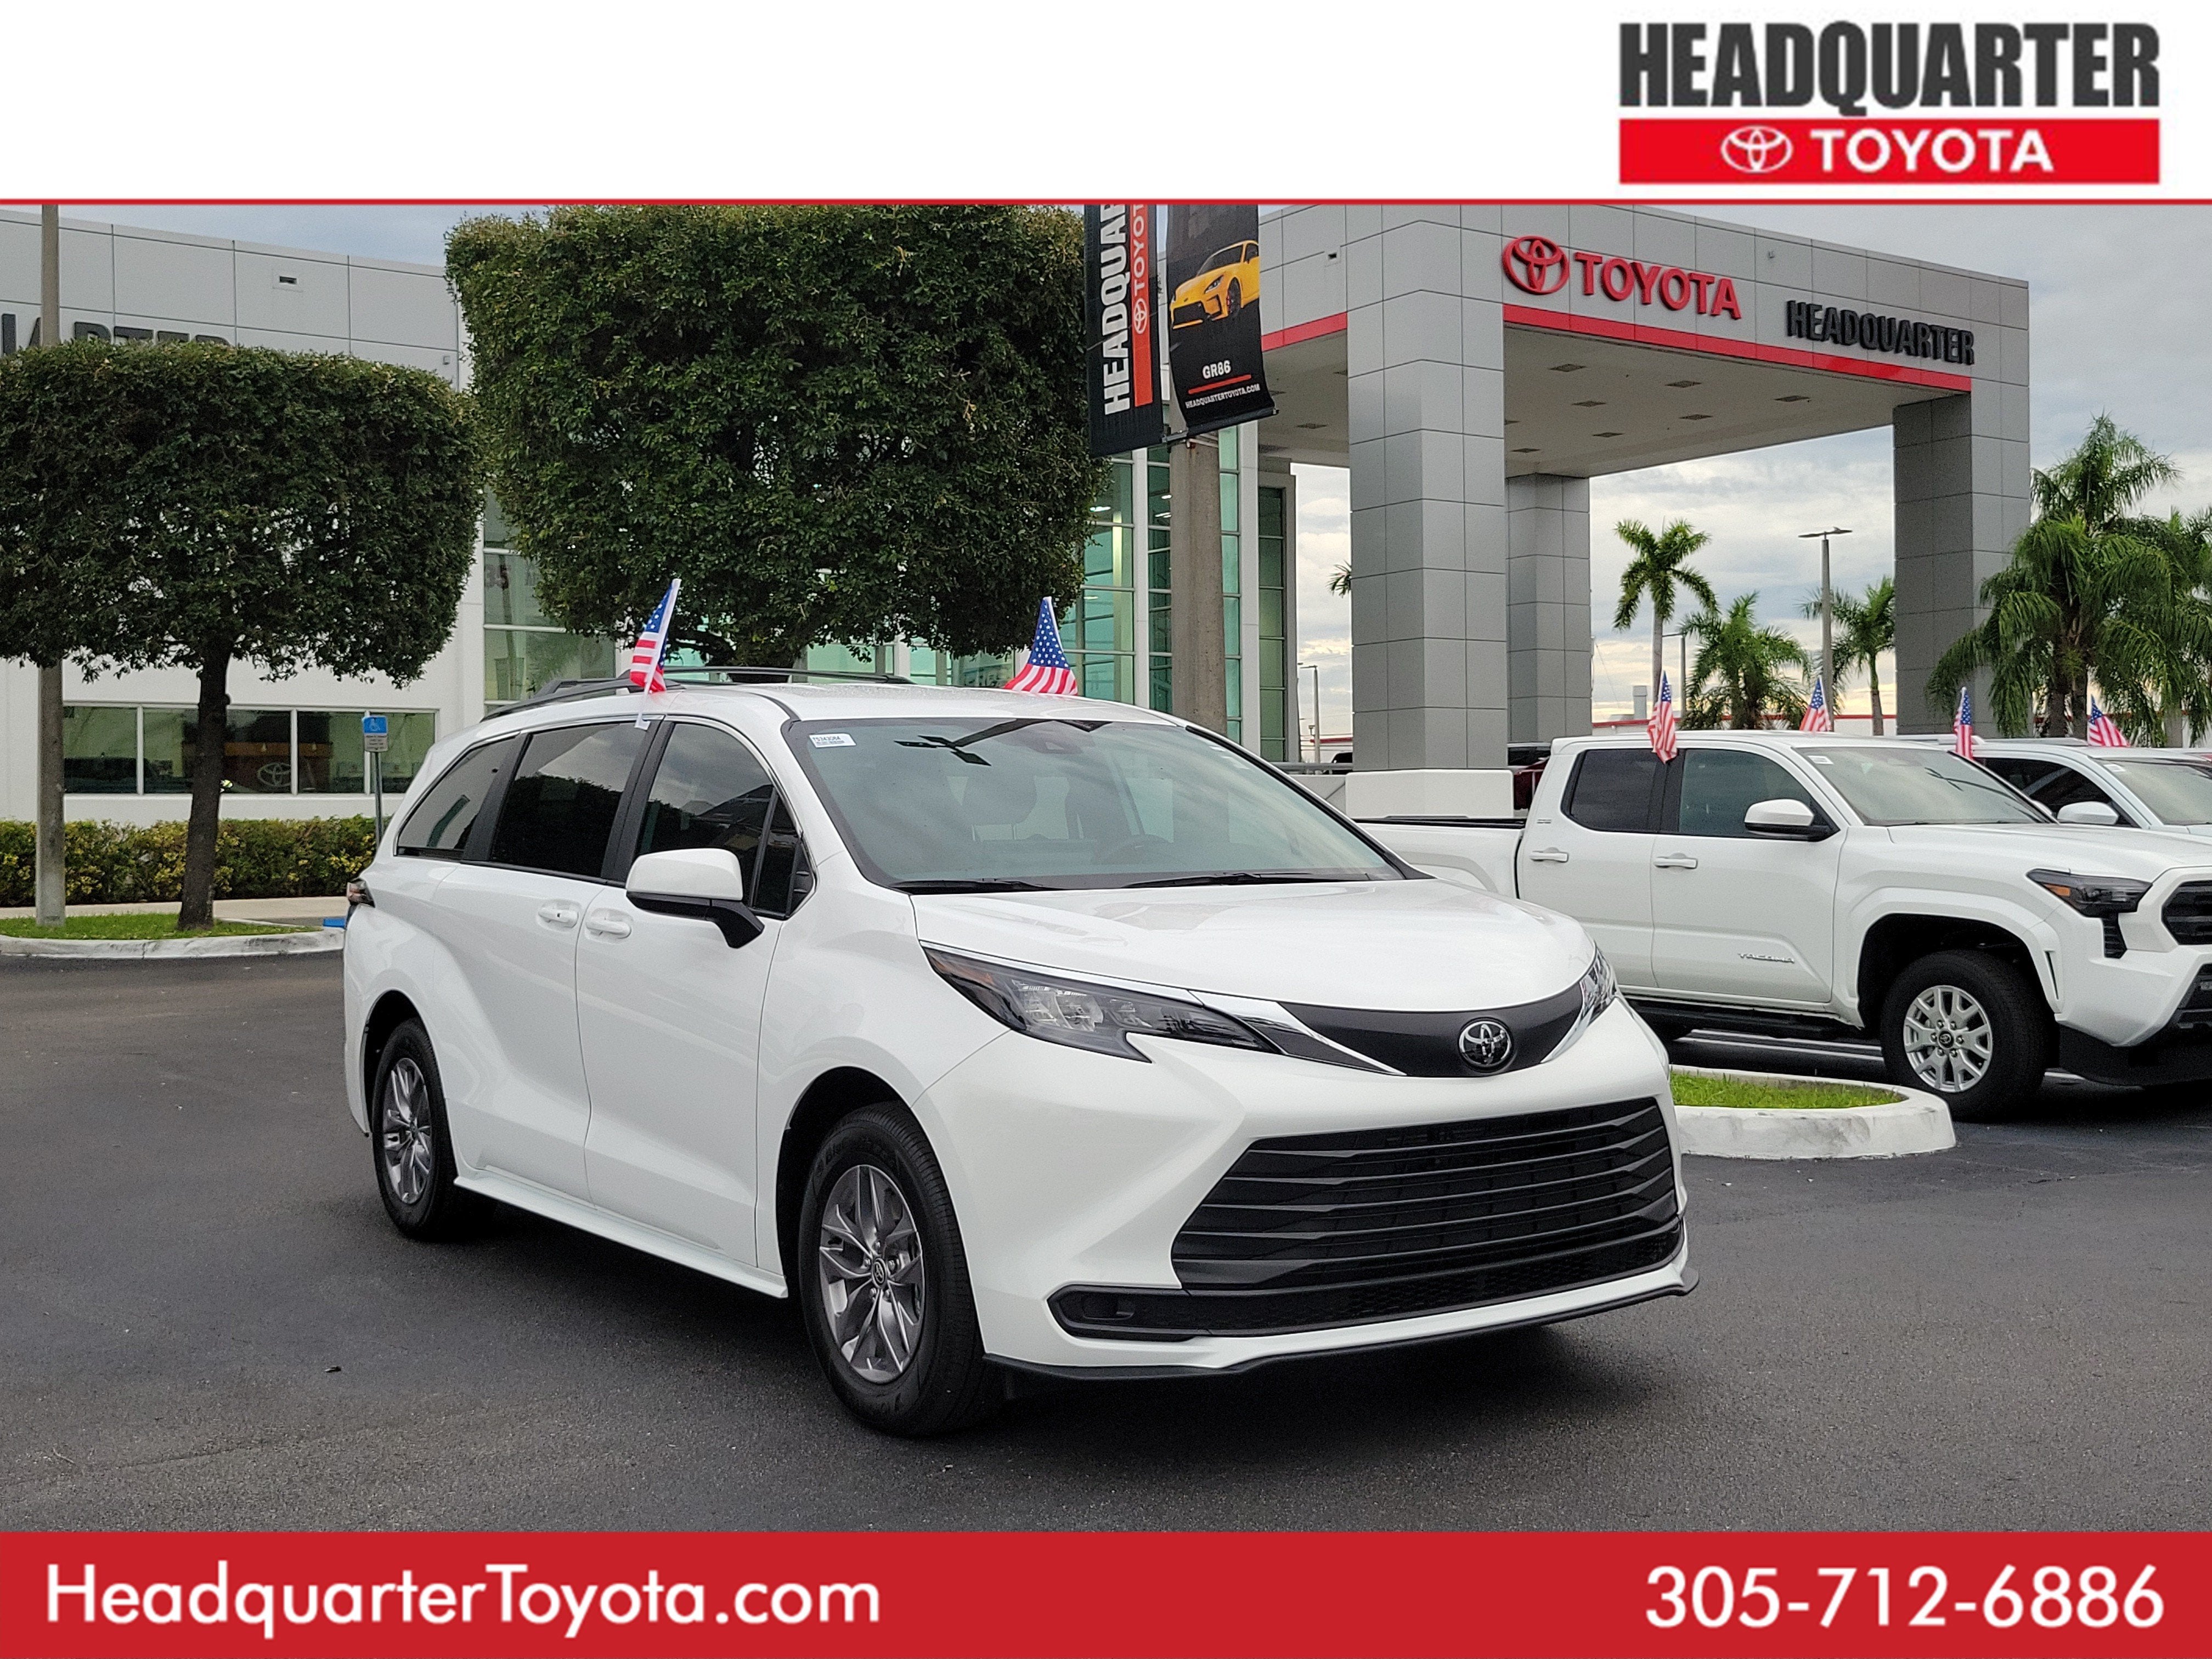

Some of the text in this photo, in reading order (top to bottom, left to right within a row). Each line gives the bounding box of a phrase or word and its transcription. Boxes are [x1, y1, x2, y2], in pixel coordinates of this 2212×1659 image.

[1575, 252, 1974, 366] TOYOTA HEADQUARTER
[1202, 360, 1232, 379] GR86
[1185, 383, 1260, 408] HEADQUARTERTOYOTA.COM
